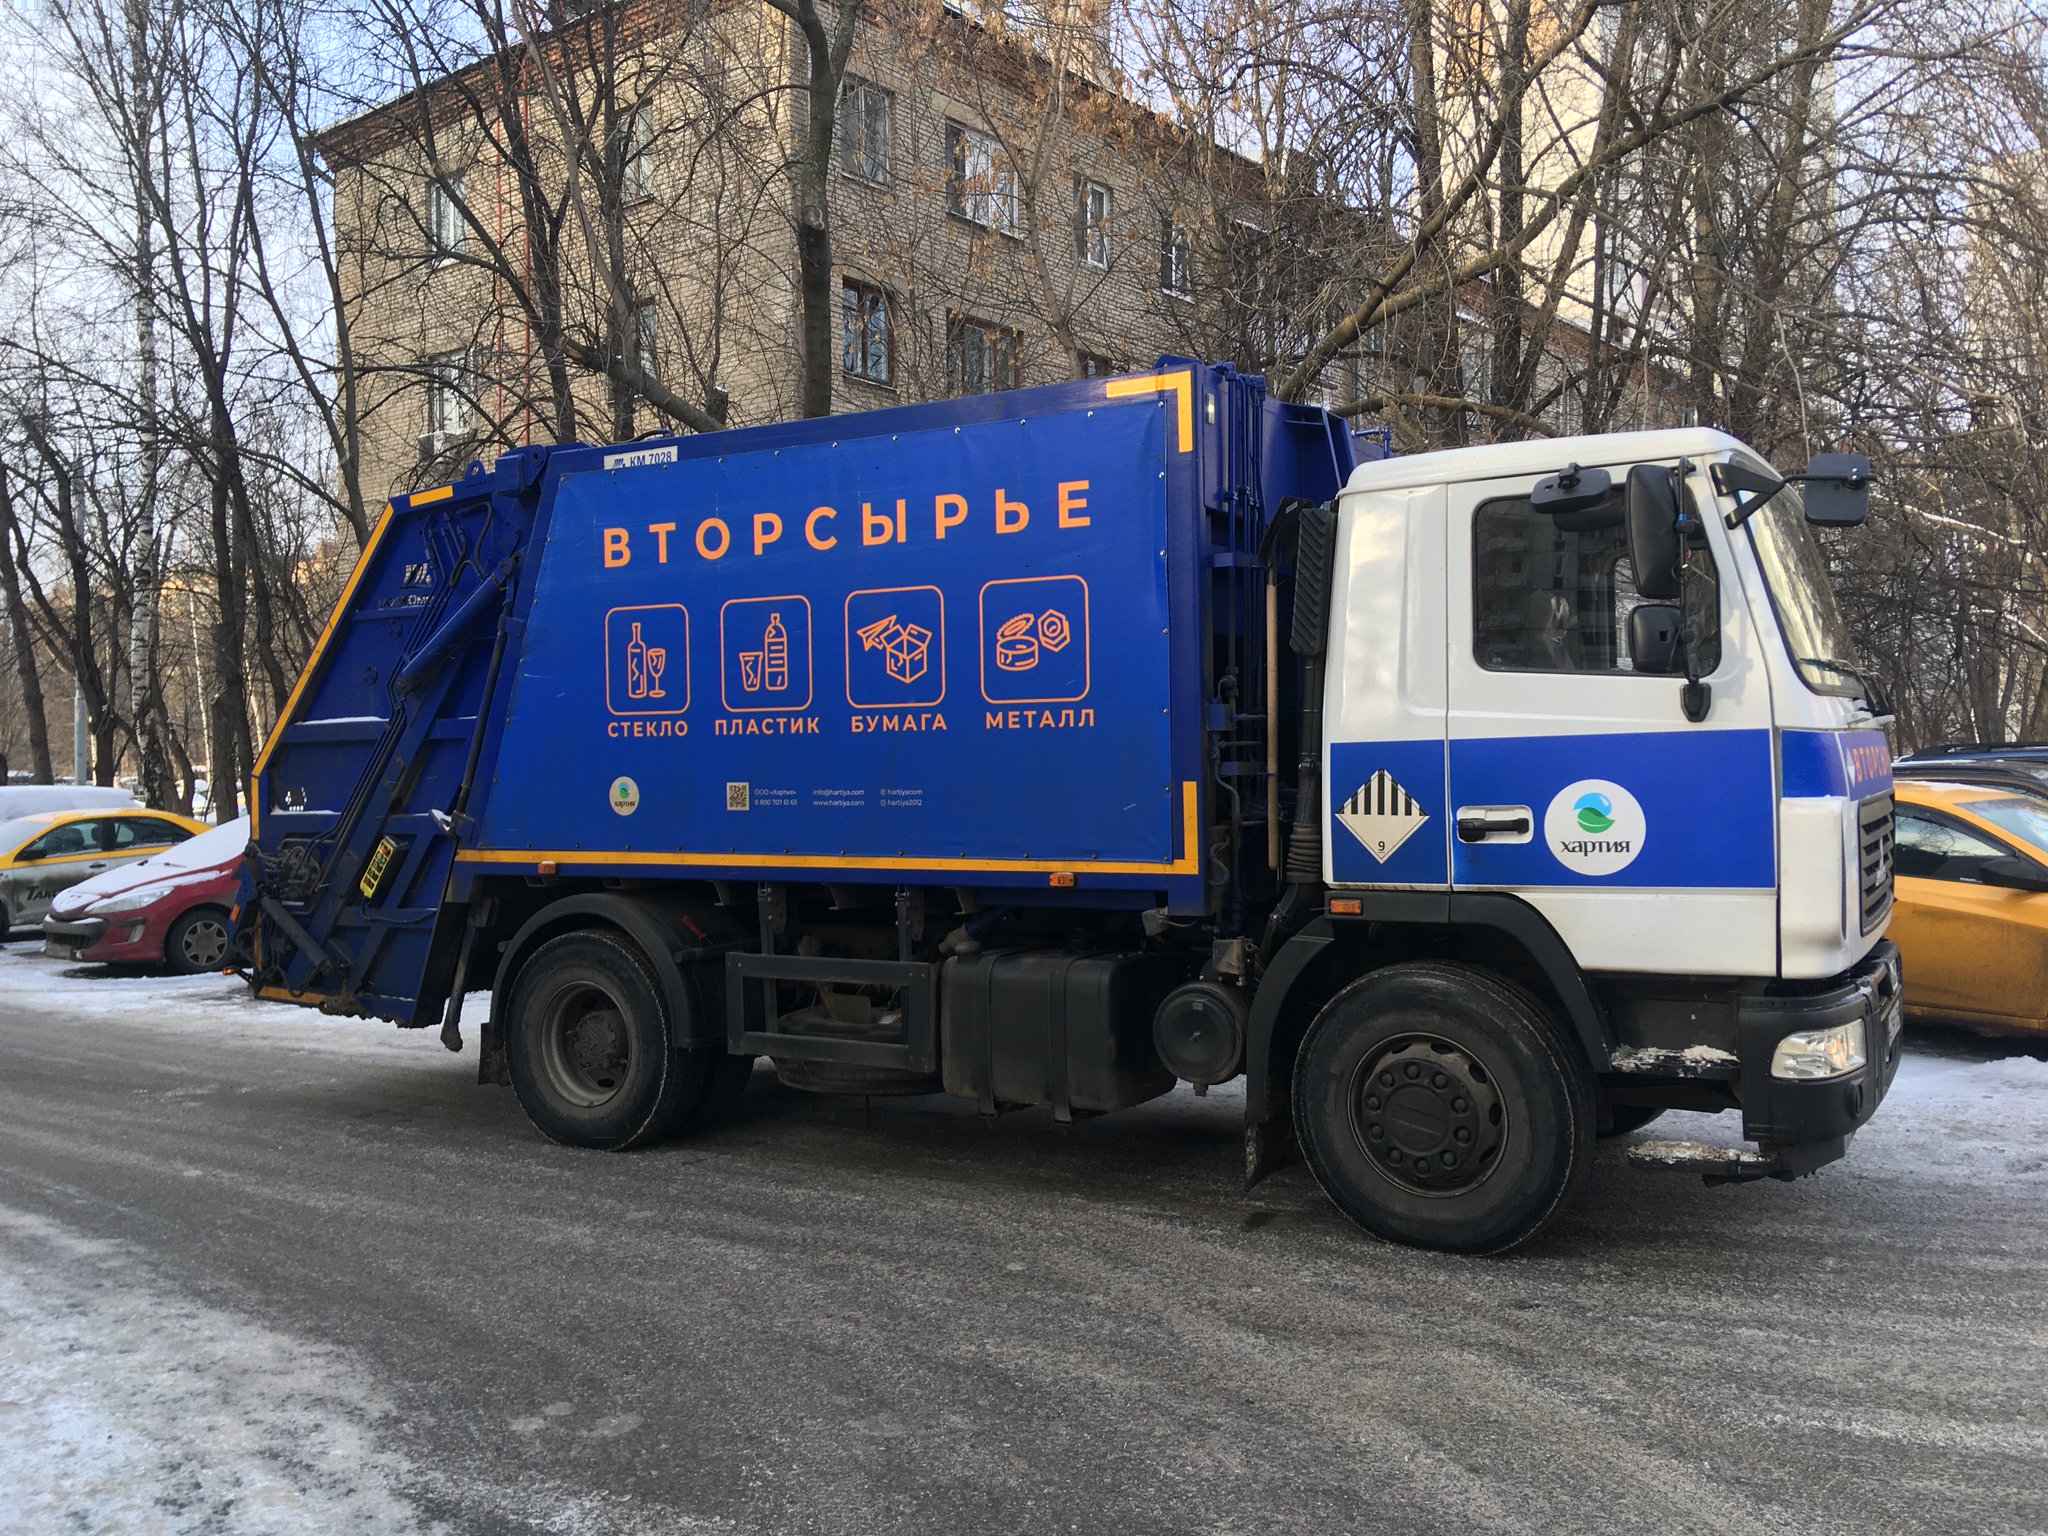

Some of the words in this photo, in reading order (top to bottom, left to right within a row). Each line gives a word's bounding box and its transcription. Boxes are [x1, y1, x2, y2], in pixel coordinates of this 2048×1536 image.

[649, 451, 672, 465] 7028
[603, 480, 1091, 568] ВТОРСЫРЬЕ
[715, 717, 819, 735] ПЛАСТИК
[851, 713, 947, 733] БУМАГА
[985, 708, 1094, 729] МЕТАЛЛ
[607, 720, 688, 738] СТЕКЛО
[754, 788, 769, 796] ООО
[812, 788, 865, 797] info@hartiya.com
[812, 799, 865, 807] www.hartiya.com
[887, 798, 923, 807] hartiya2012
[1378, 840, 1386, 852] 9
[1559, 840, 1632, 857] хартия
